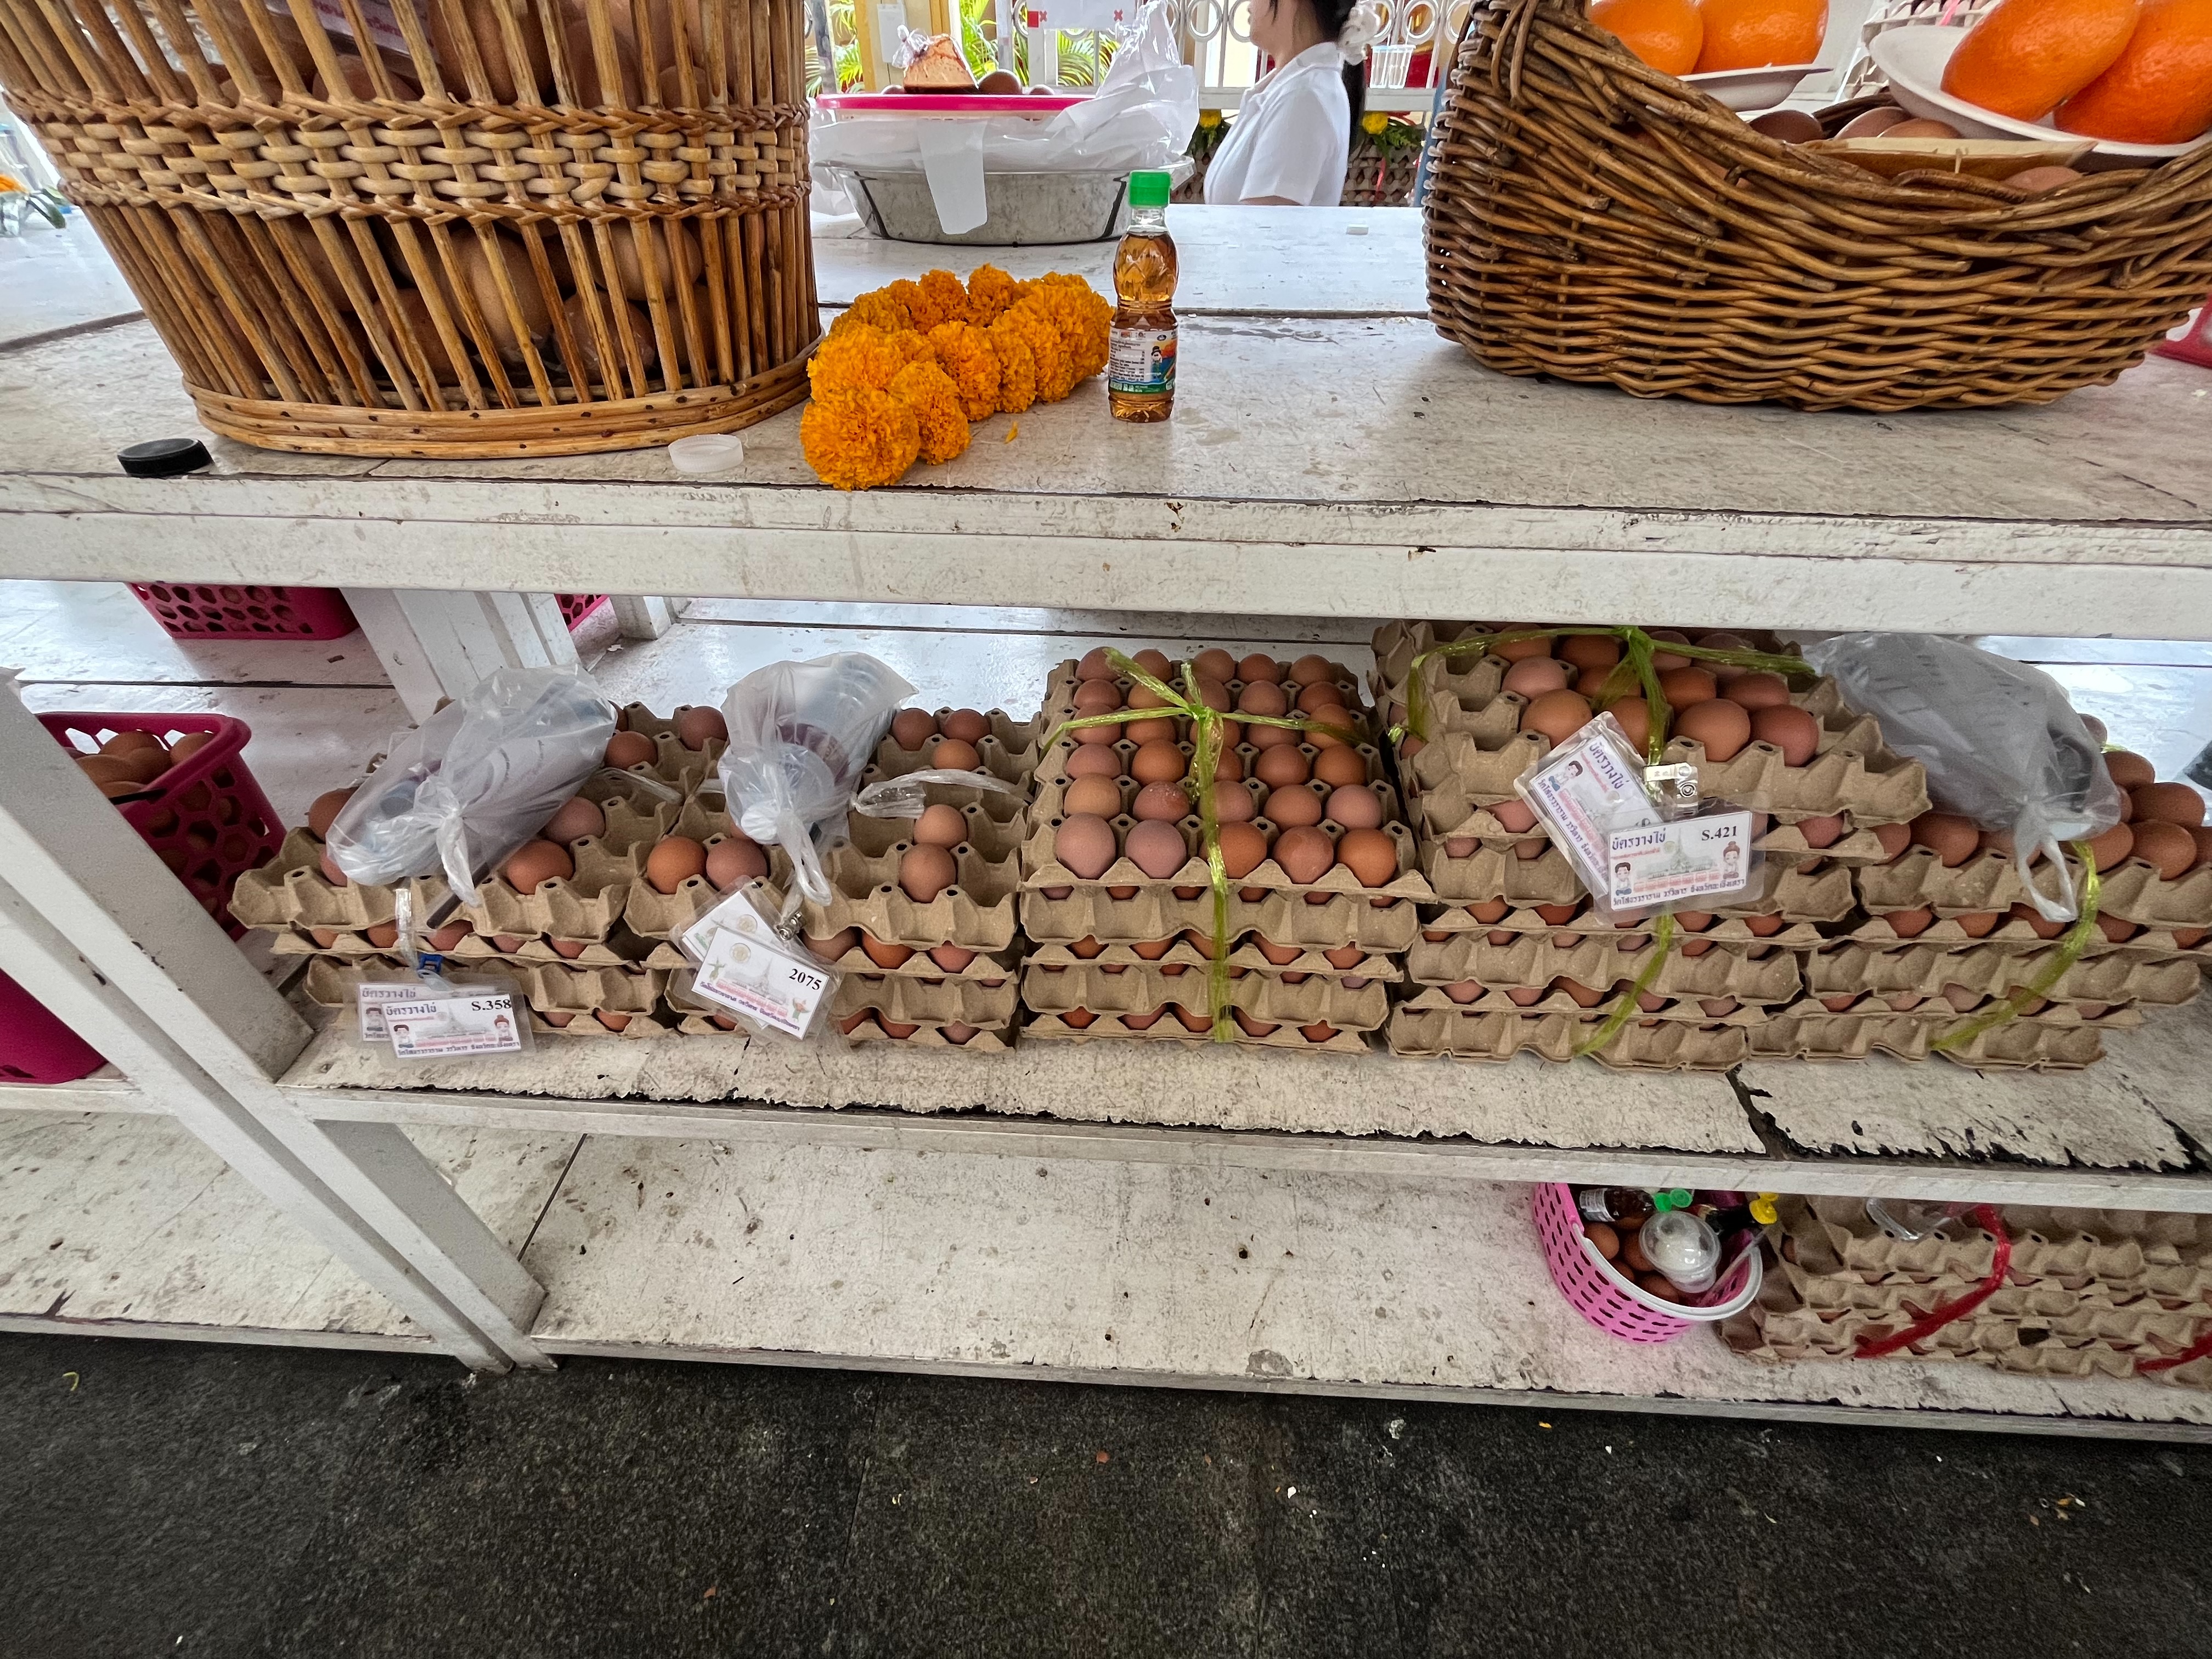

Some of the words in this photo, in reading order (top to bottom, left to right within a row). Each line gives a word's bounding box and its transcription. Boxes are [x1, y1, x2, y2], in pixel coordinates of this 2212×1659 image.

[1589, 742, 1629, 789] บัตรวางไข่
[1612, 828, 1666, 850] บัตรวางไข่
[1702, 826, 1737, 841] S.421
[789, 968, 822, 990] 2075
[362, 988, 416, 998] บัตรวางไข่
[386, 1002, 437, 1015] บัตรวางไข่
[471, 999, 512, 1011] S.358
